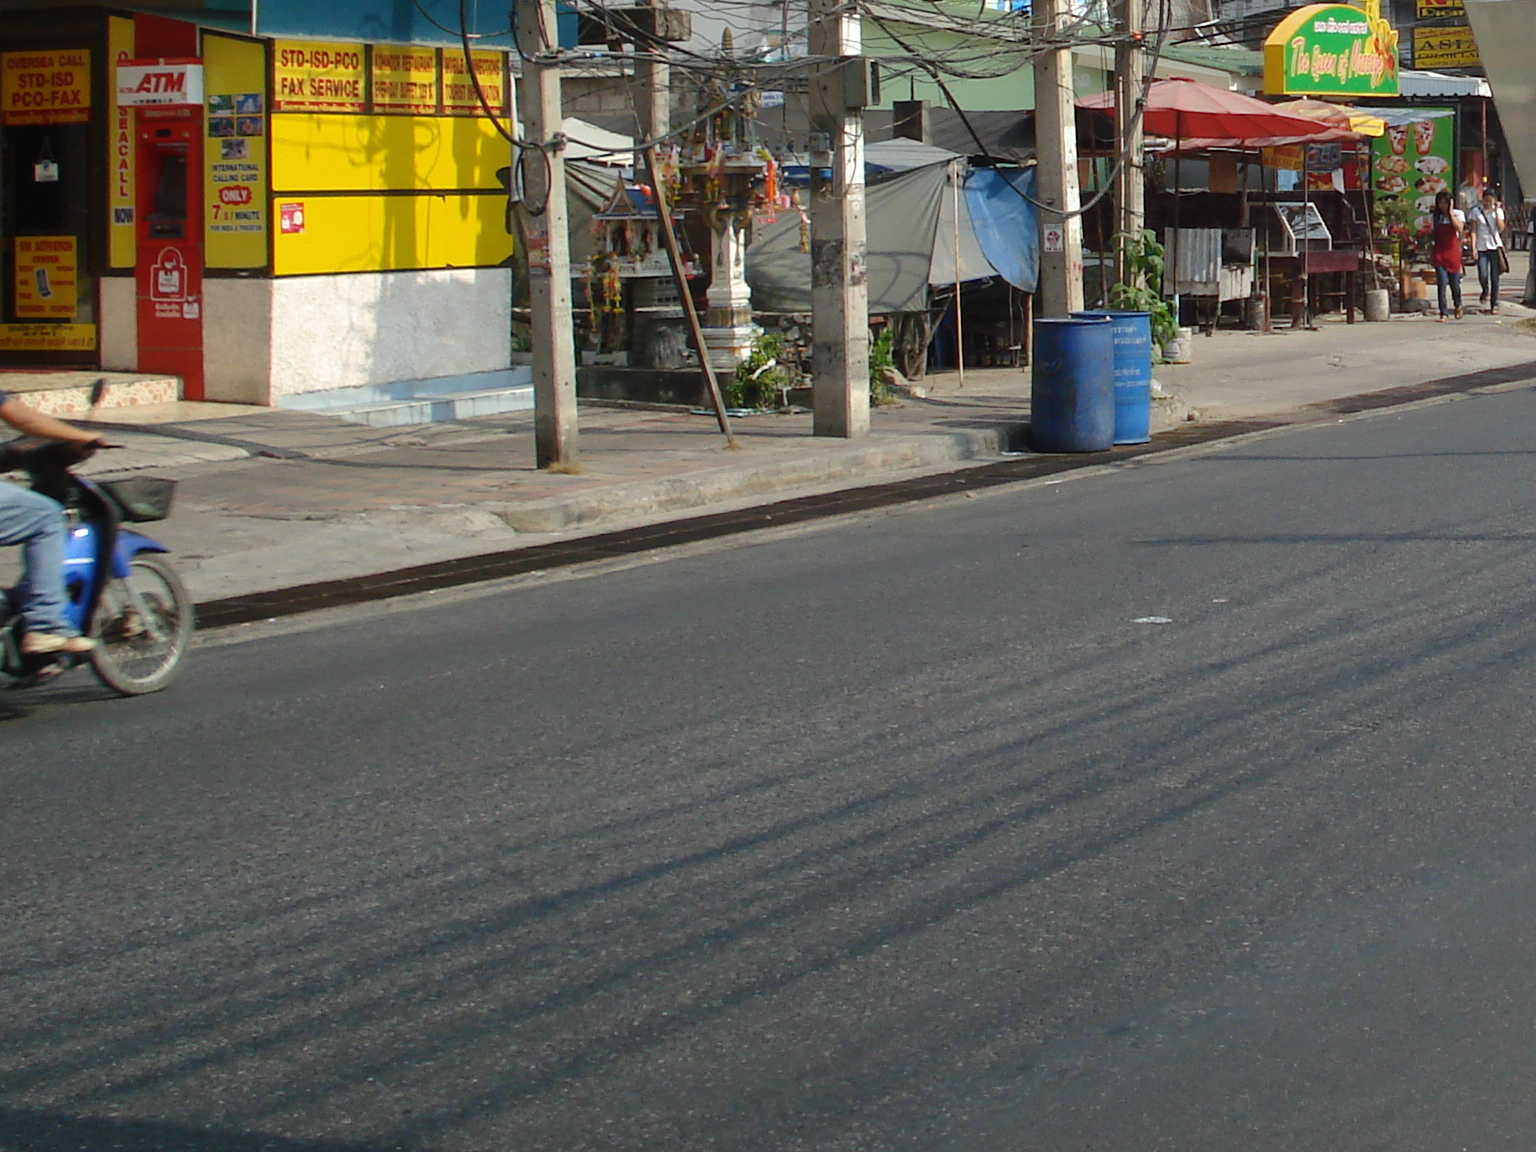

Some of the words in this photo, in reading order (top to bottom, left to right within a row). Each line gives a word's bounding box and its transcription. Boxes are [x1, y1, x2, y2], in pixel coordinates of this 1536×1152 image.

[7, 56, 54, 70] OVERSEA
[59, 54, 85, 67] CALL
[281, 49, 359, 70] STD-ISD-PCO
[1292, 36, 1309, 77] The
[18, 71, 74, 89] STD-ISD
[135, 72, 186, 94] ATM
[281, 77, 304, 96] FAX
[309, 78, 359, 97] SERVICE
[12, 90, 81, 107] PCO-FAX
[212, 164, 258, 172] INTERNATIONAL
[213, 174, 239, 182] CALLING
[222, 189, 248, 202] ONLY
[115, 208, 134, 224] NOW
[212, 204, 221, 220] 7
